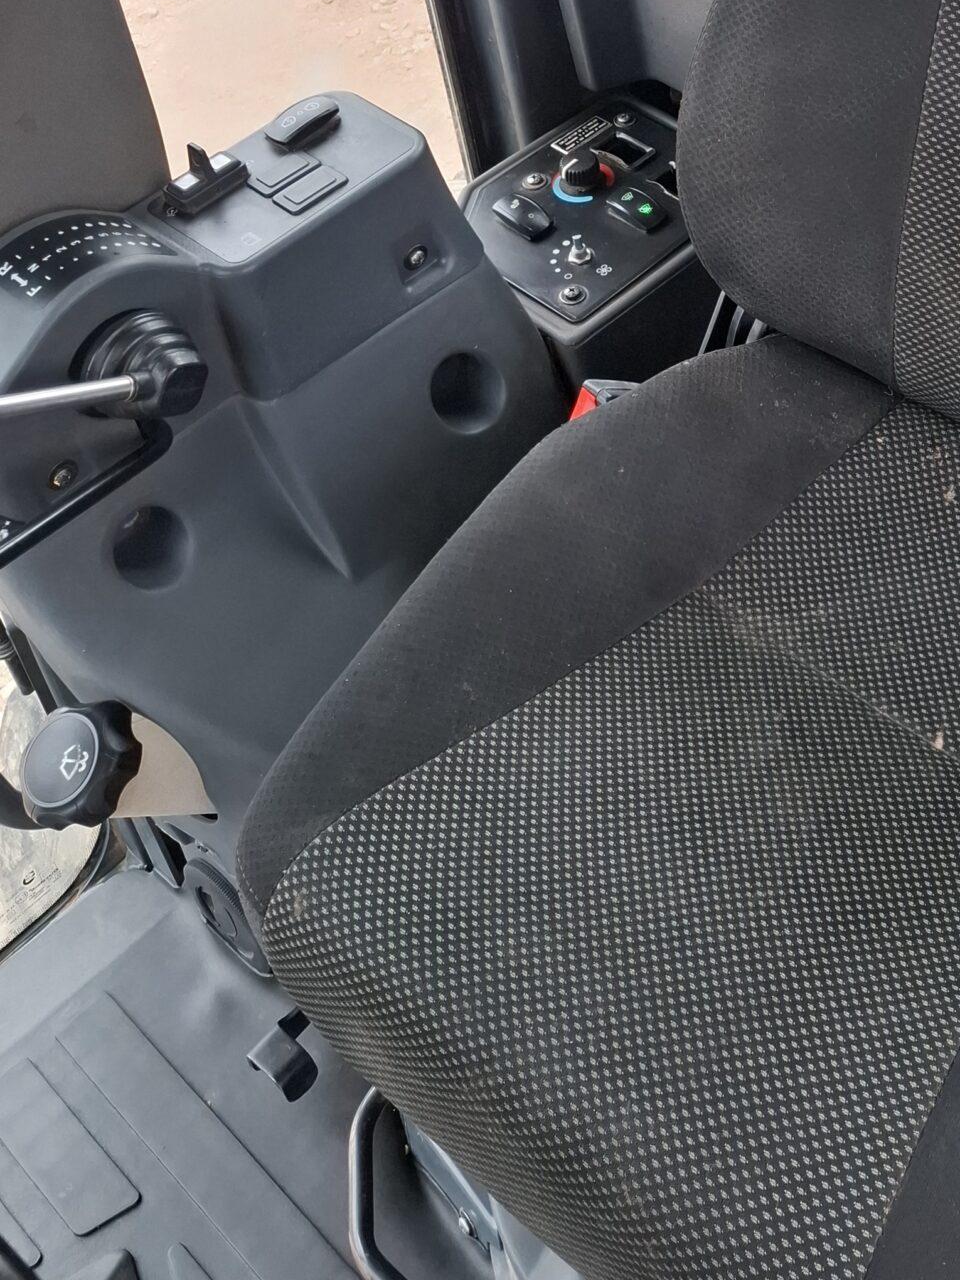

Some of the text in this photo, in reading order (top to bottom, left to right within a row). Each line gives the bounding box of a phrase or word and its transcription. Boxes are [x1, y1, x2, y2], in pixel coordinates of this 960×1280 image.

[0, 262, 13, 277] R
[28, 264, 40, 272] N
[25, 286, 42, 297] F
